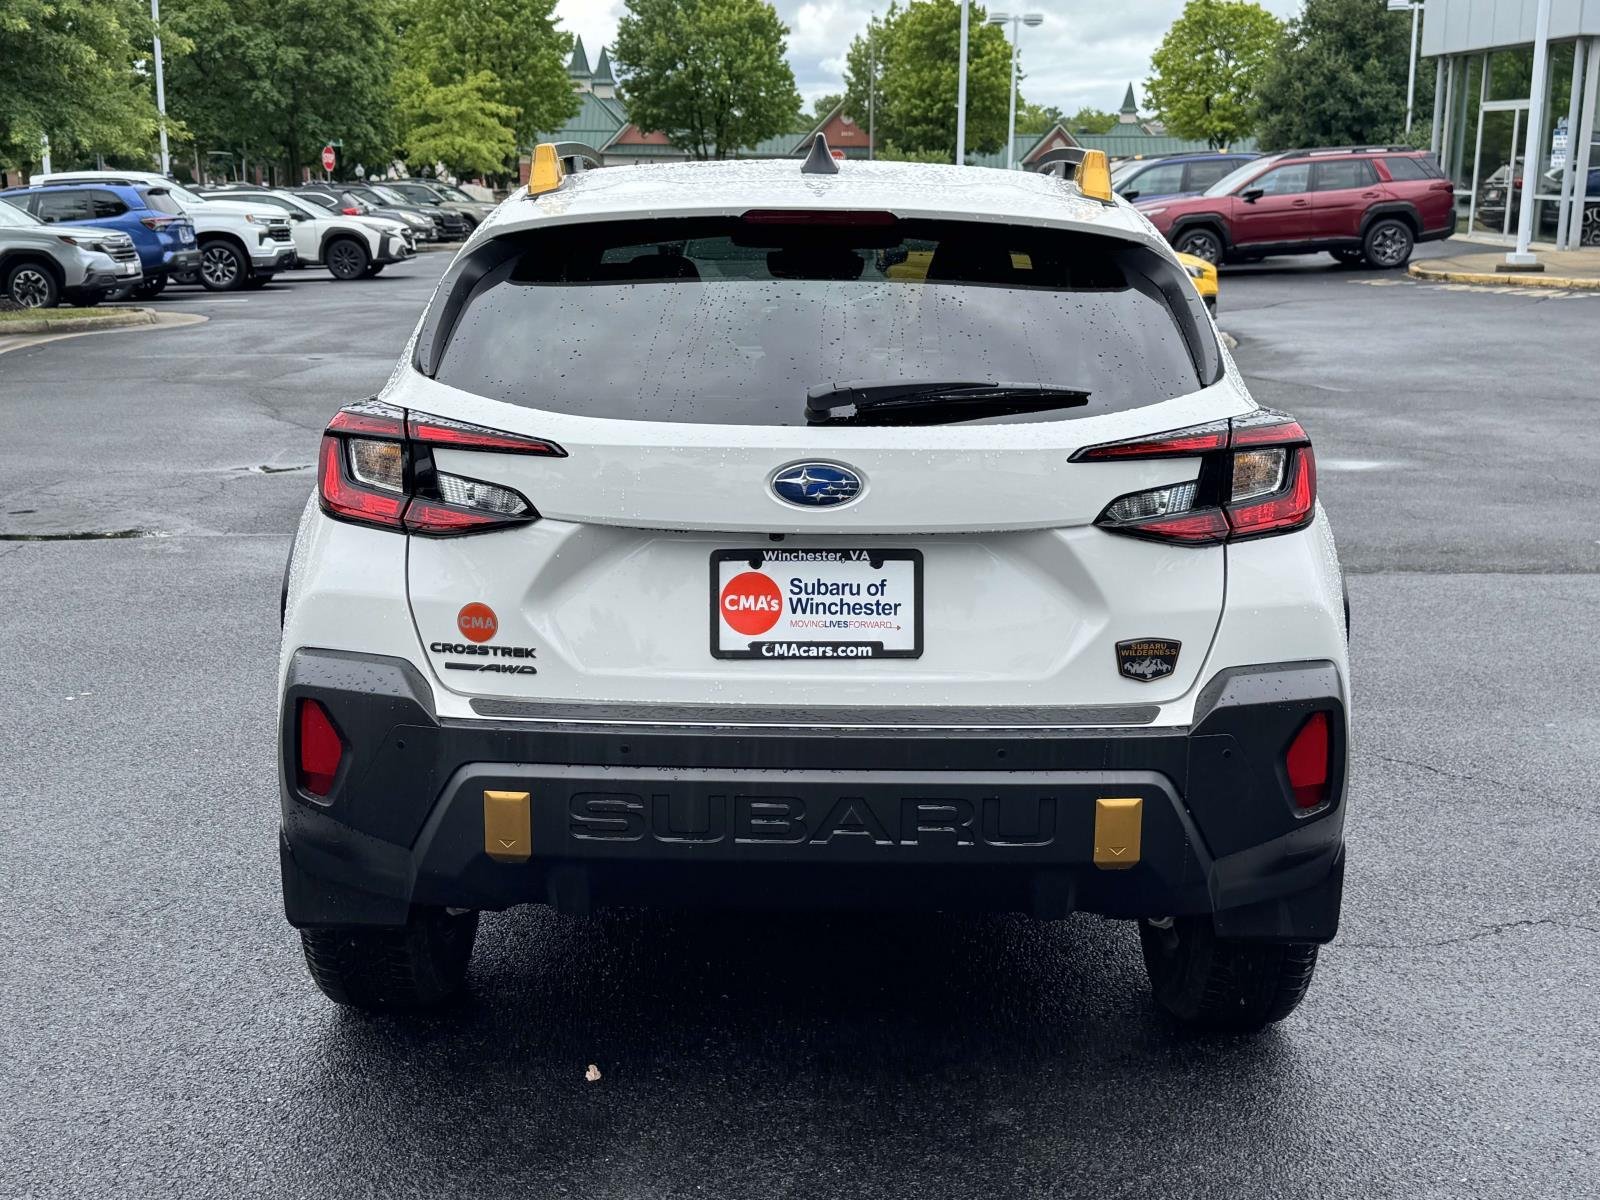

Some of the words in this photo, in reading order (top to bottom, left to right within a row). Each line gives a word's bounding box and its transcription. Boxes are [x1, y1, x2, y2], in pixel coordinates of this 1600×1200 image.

[763, 550, 845, 563] Winchester,
[849, 550, 870, 561] VA
[789, 577, 860, 596] Subaru
[867, 578, 887, 596] of
[724, 594, 780, 611] CMA's
[789, 597, 901, 616] Winchester
[460, 615, 495, 629] CMA
[430, 642, 536, 658] CROSSTREK
[761, 643, 873, 657] CMAcars.com
[479, 664, 537, 674] AWD
[570, 792, 1057, 847] SUBARU
